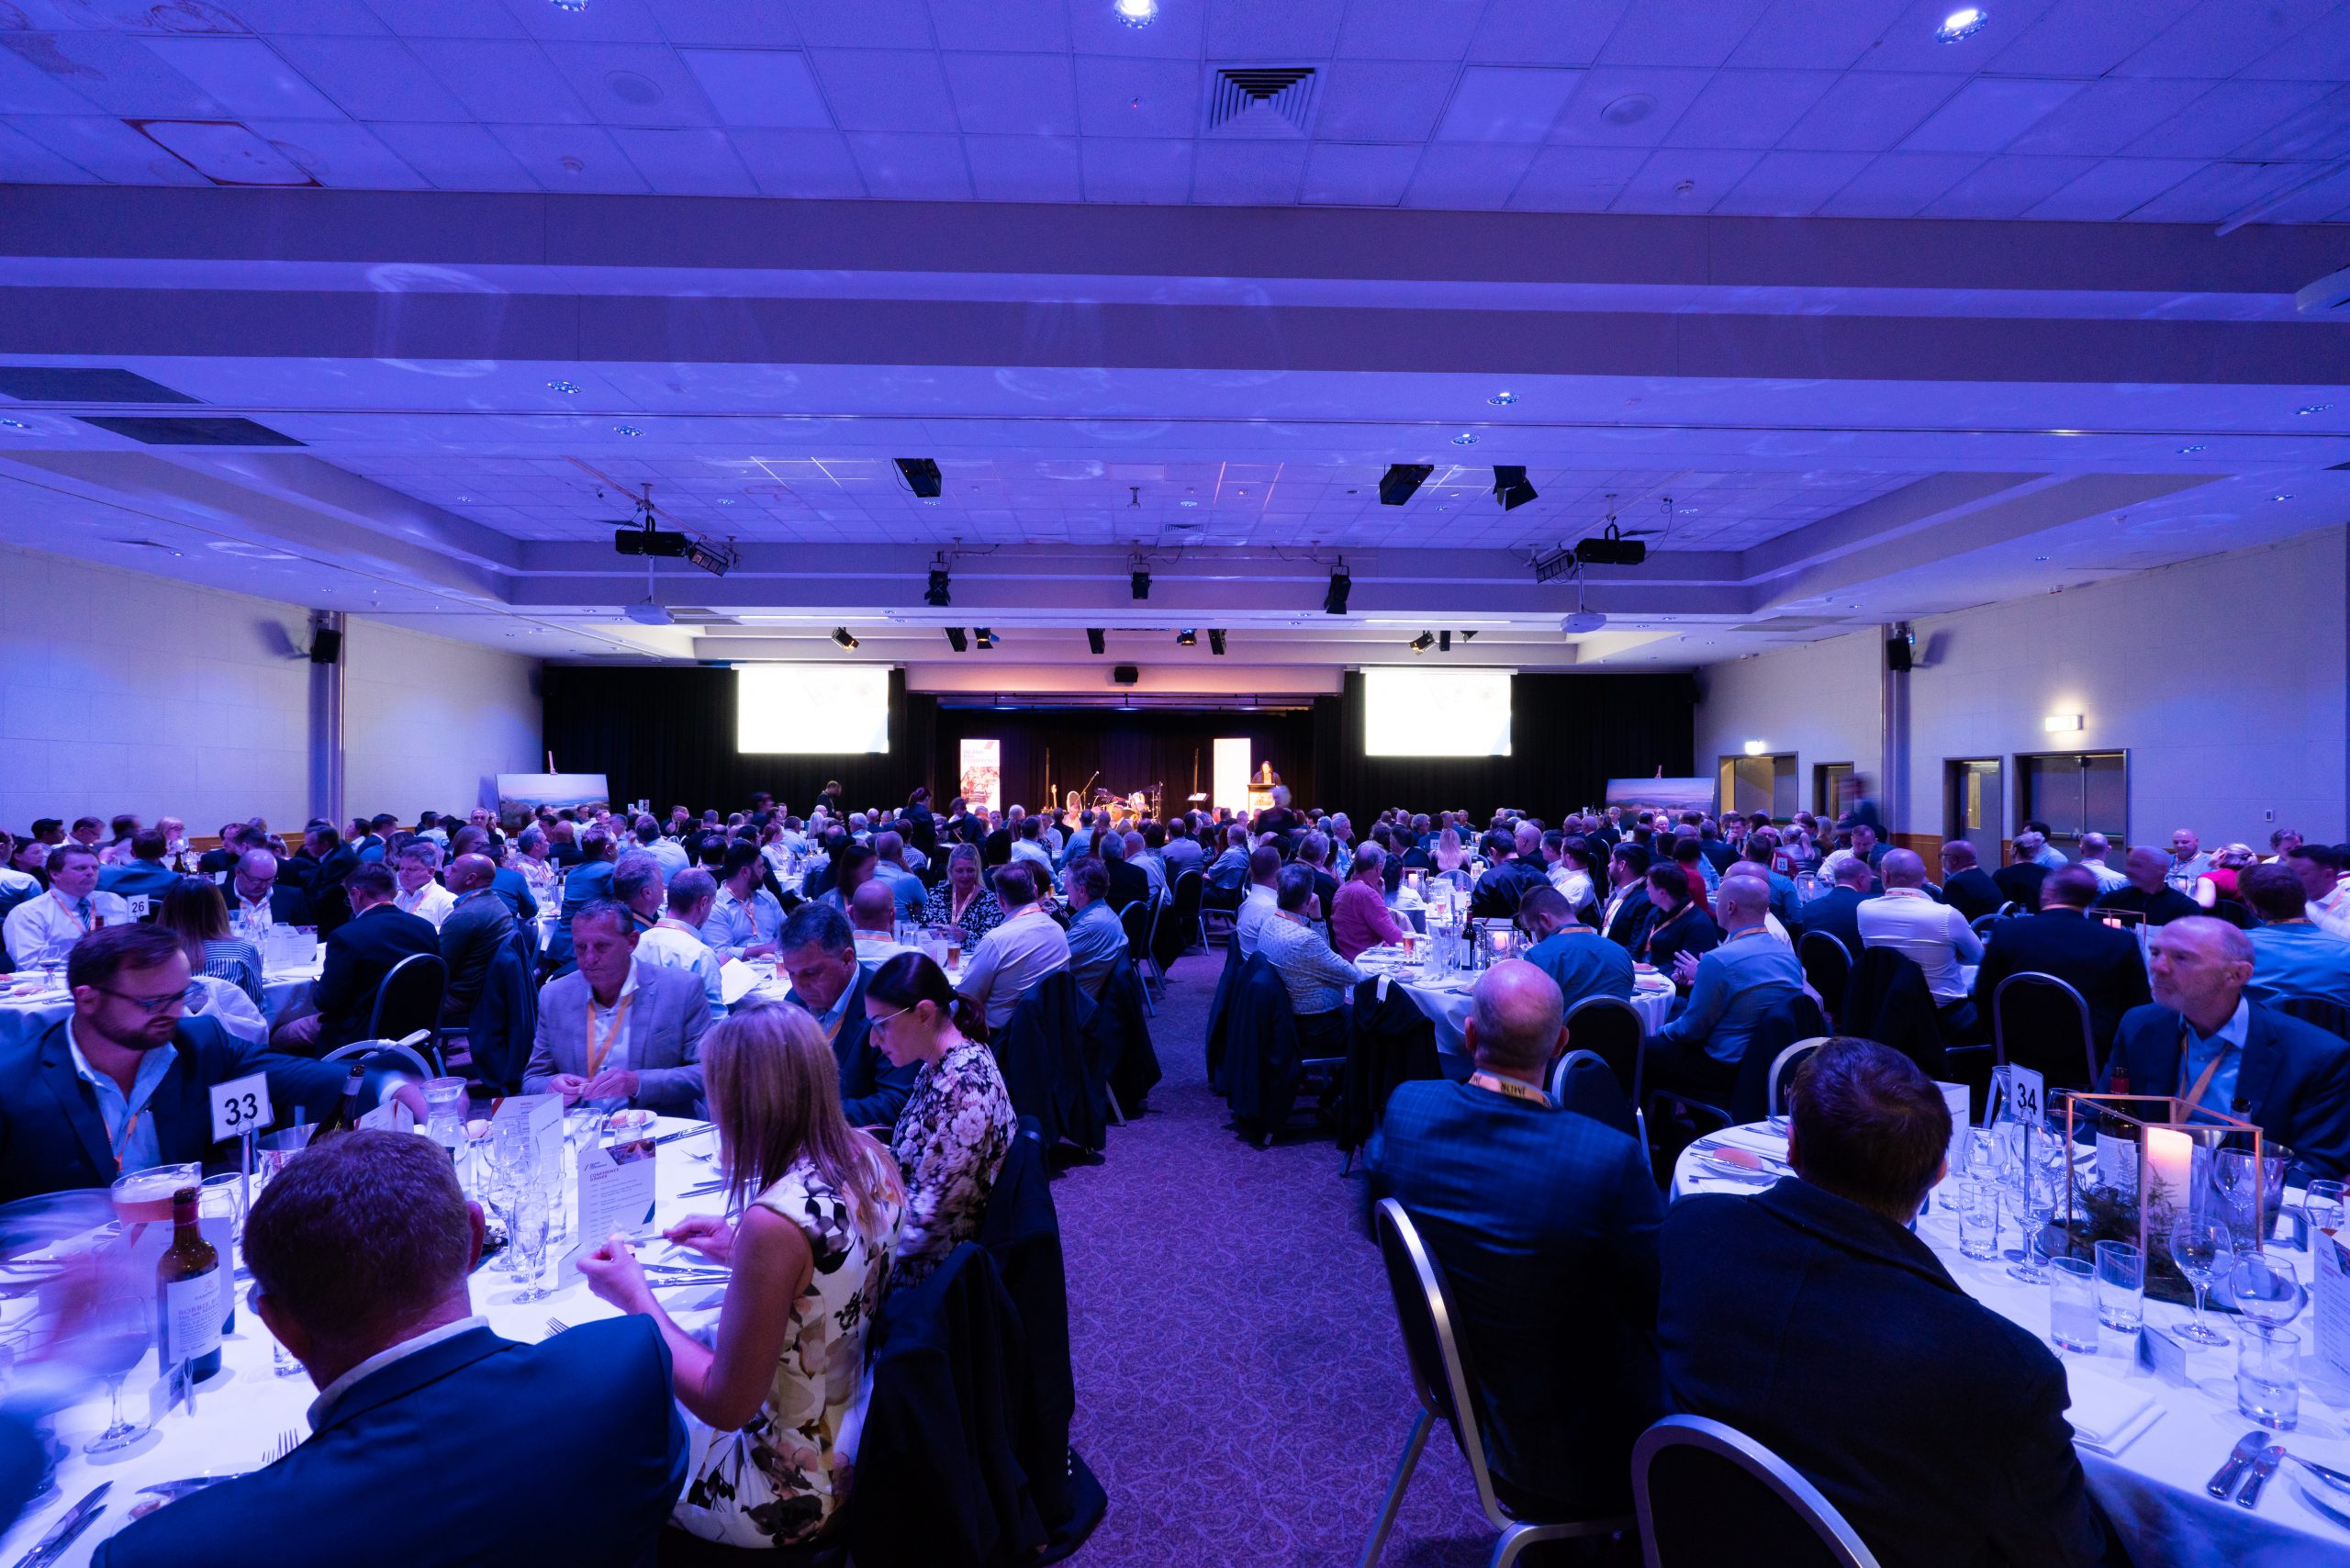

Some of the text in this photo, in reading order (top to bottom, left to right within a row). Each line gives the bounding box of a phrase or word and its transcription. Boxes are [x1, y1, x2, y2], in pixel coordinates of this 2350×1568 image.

[131, 901, 145, 913] 26
[223, 1092, 258, 1126] 33
[2017, 1082, 2037, 1114] 34
